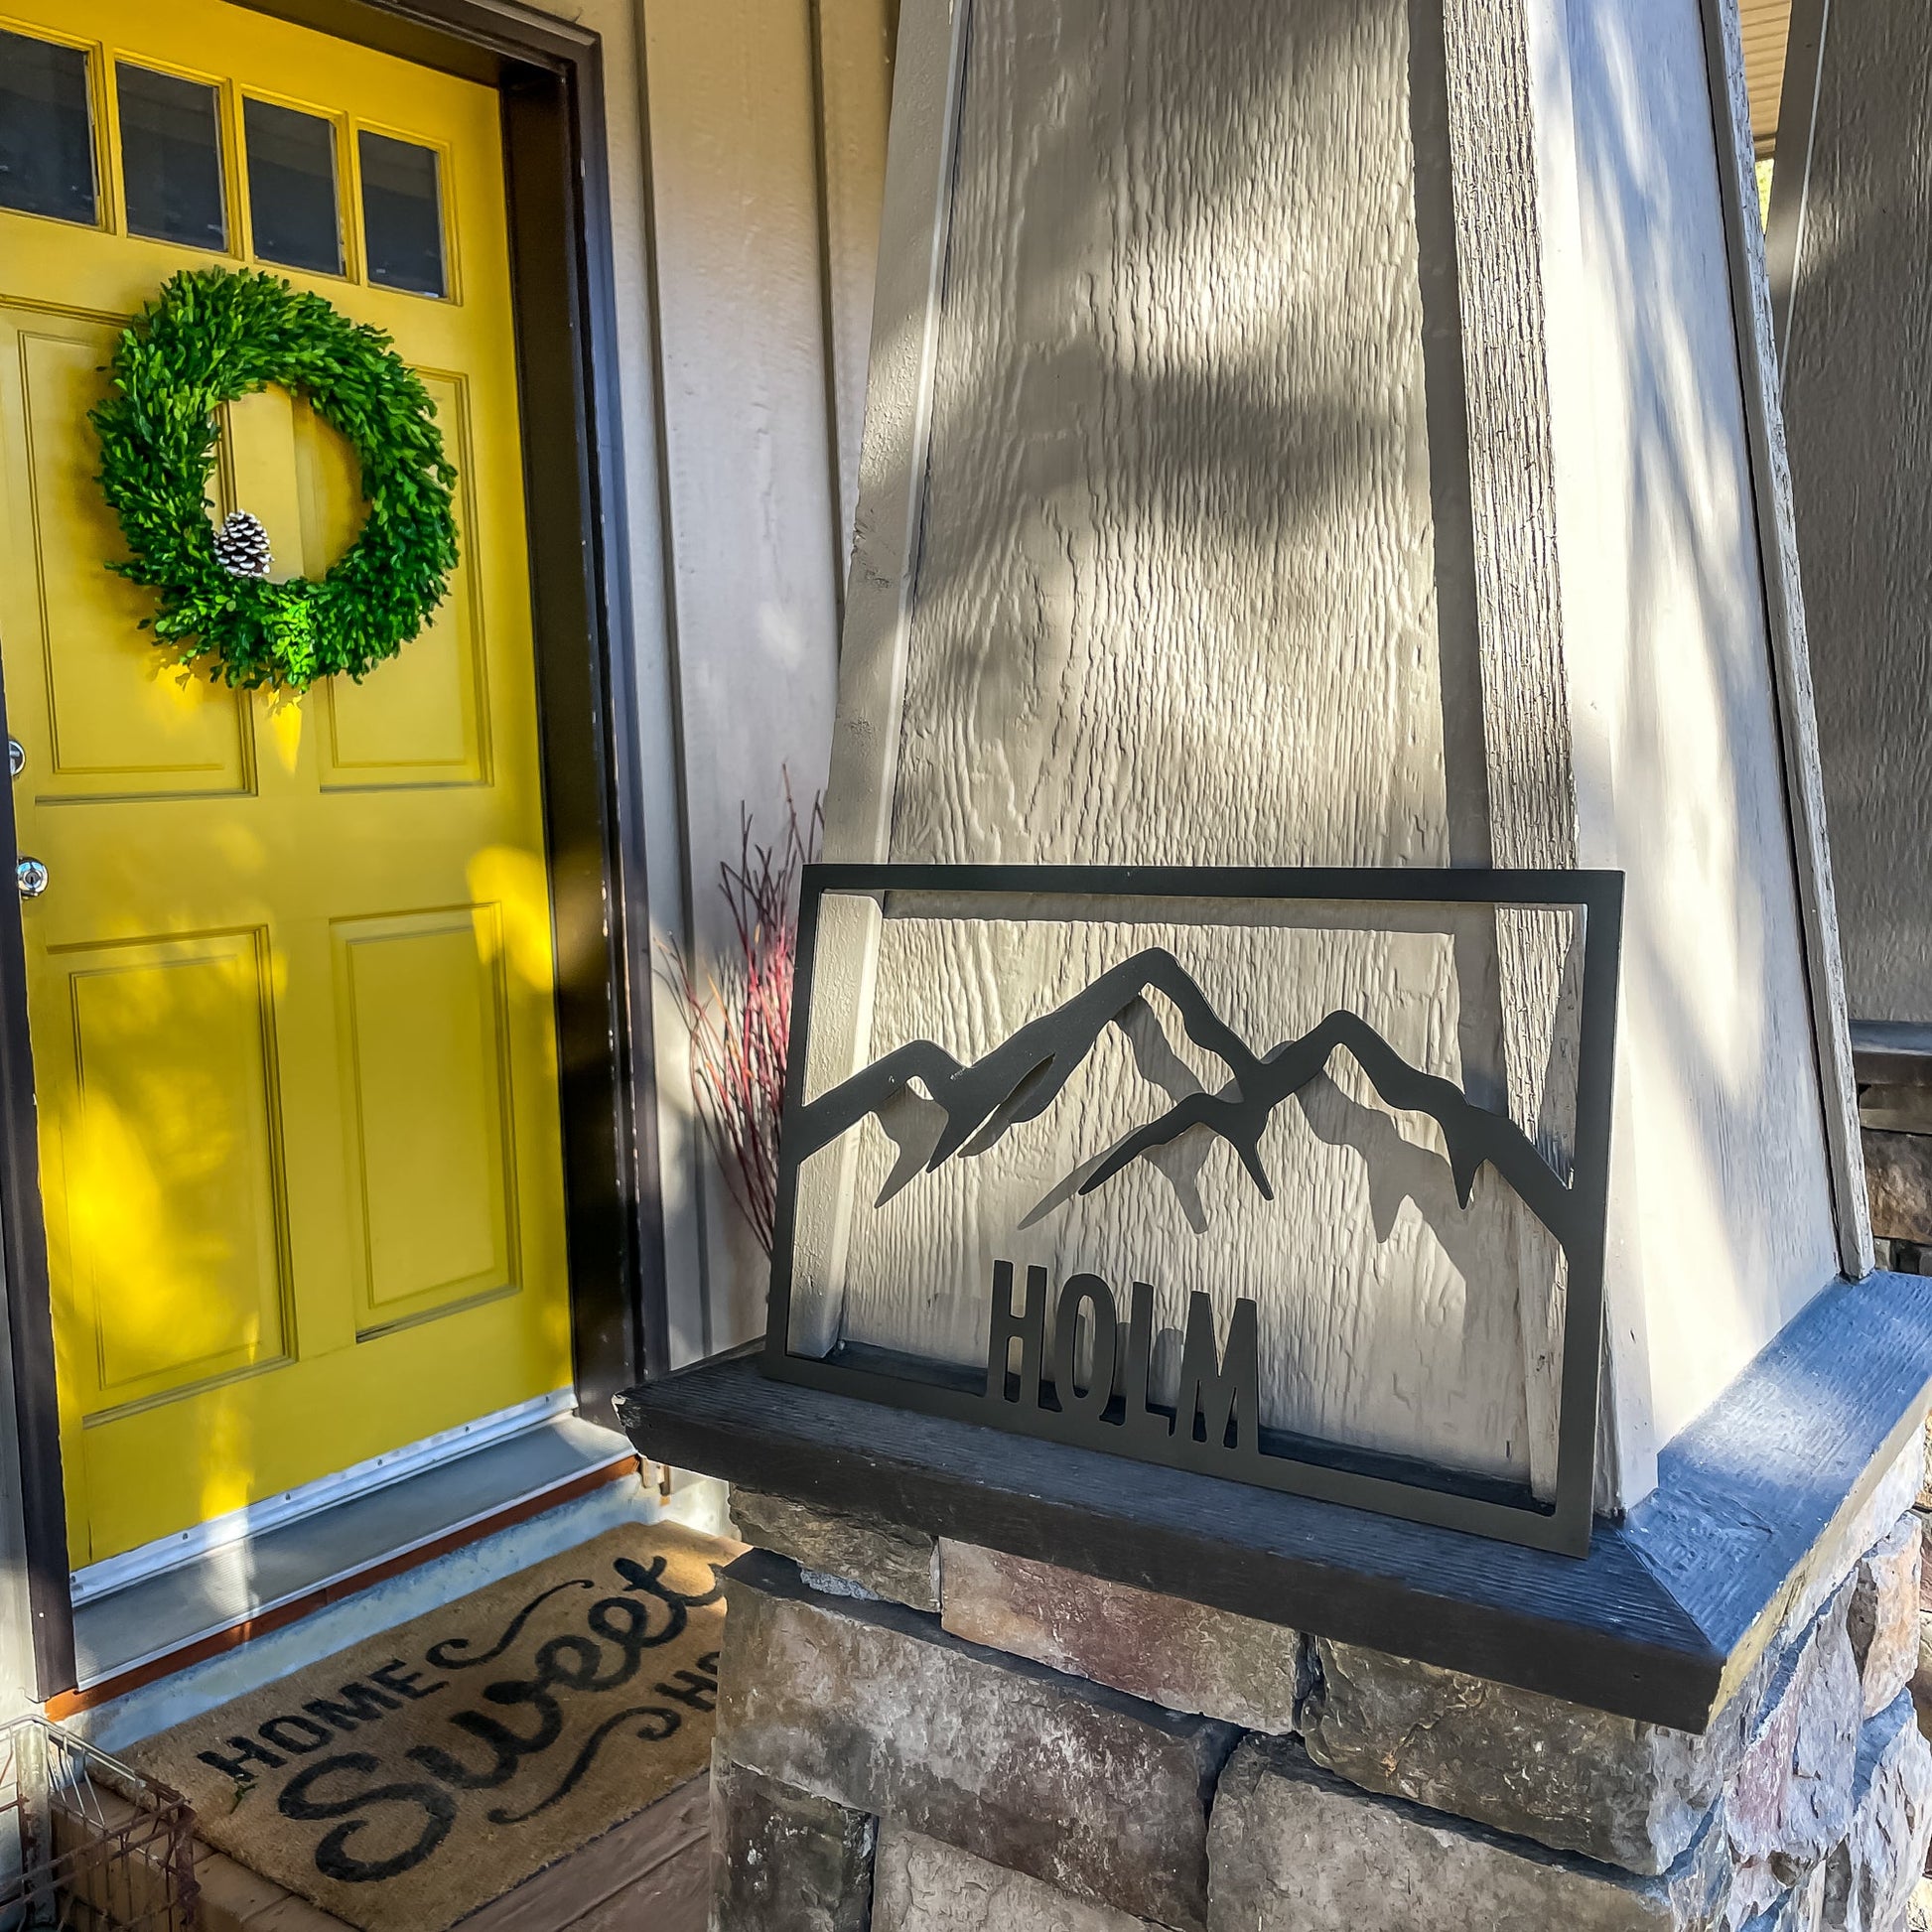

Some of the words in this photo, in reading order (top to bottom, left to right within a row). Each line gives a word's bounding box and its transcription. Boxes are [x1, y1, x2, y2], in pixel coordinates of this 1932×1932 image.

[988, 1259, 1260, 1449] HOLM
[199, 1659, 449, 1781] HOME
[278, 1556, 724, 1882] Sweet
